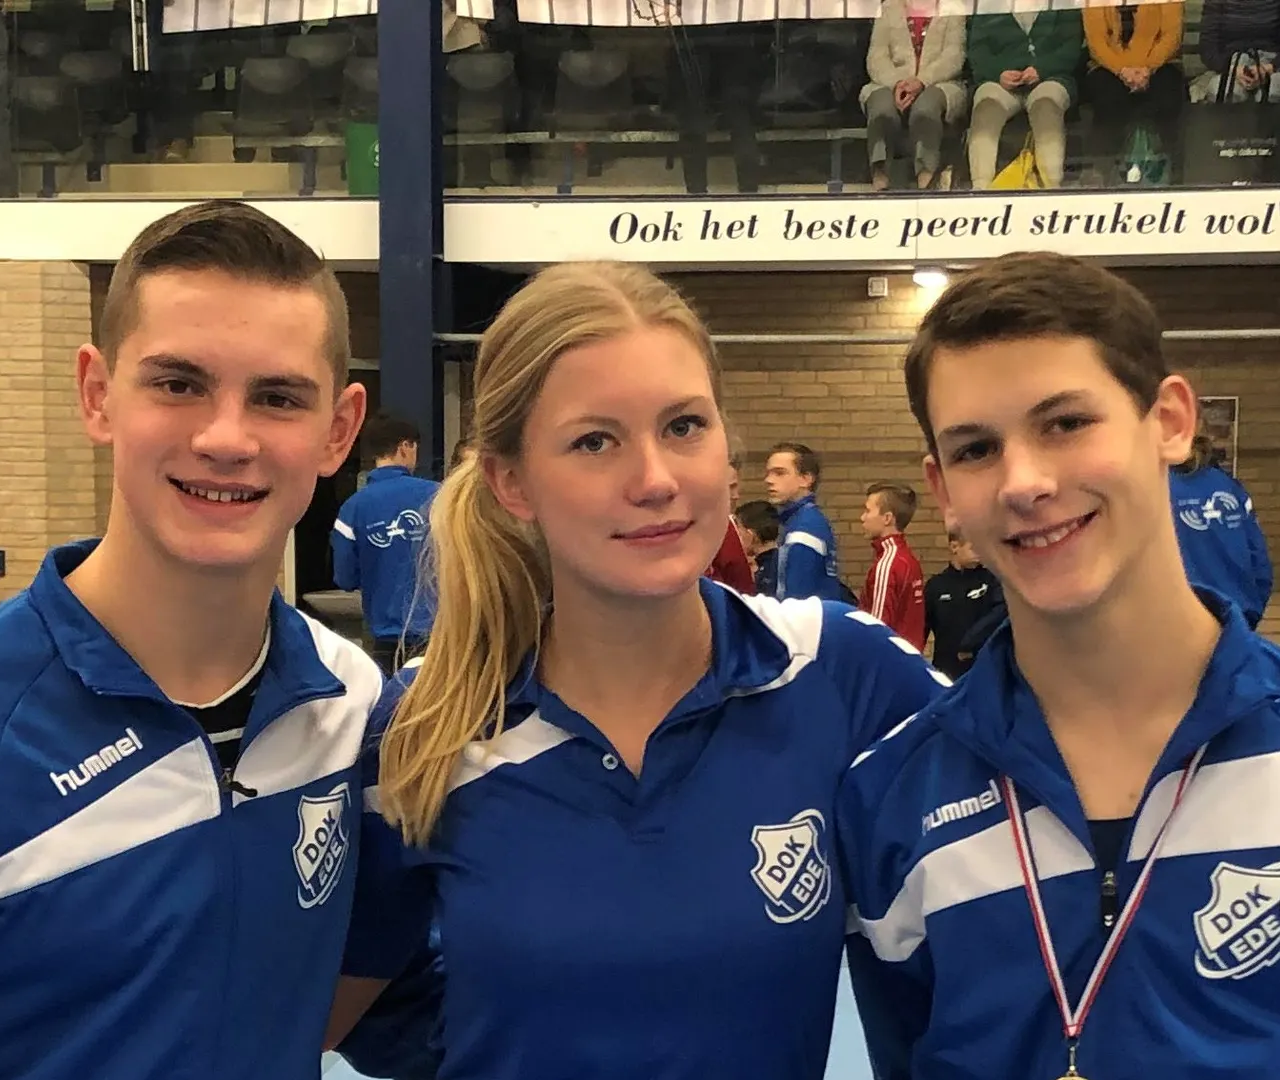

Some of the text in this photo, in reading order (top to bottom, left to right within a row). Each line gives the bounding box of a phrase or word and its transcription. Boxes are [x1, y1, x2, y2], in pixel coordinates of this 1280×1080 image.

[608, 210, 684, 245] Ook
[699, 208, 760, 241] het
[782, 208, 880, 241] beste
[895, 203, 1014, 248] peerd
[1029, 201, 1188, 237] strukelt
[49, 726, 144, 797] hummel
[302, 808, 336, 865] DOK
[317, 836, 343, 887] EDE
[765, 834, 806, 885] DOK
[790, 858, 823, 904] EDE
[1209, 883, 1272, 935] DOK
